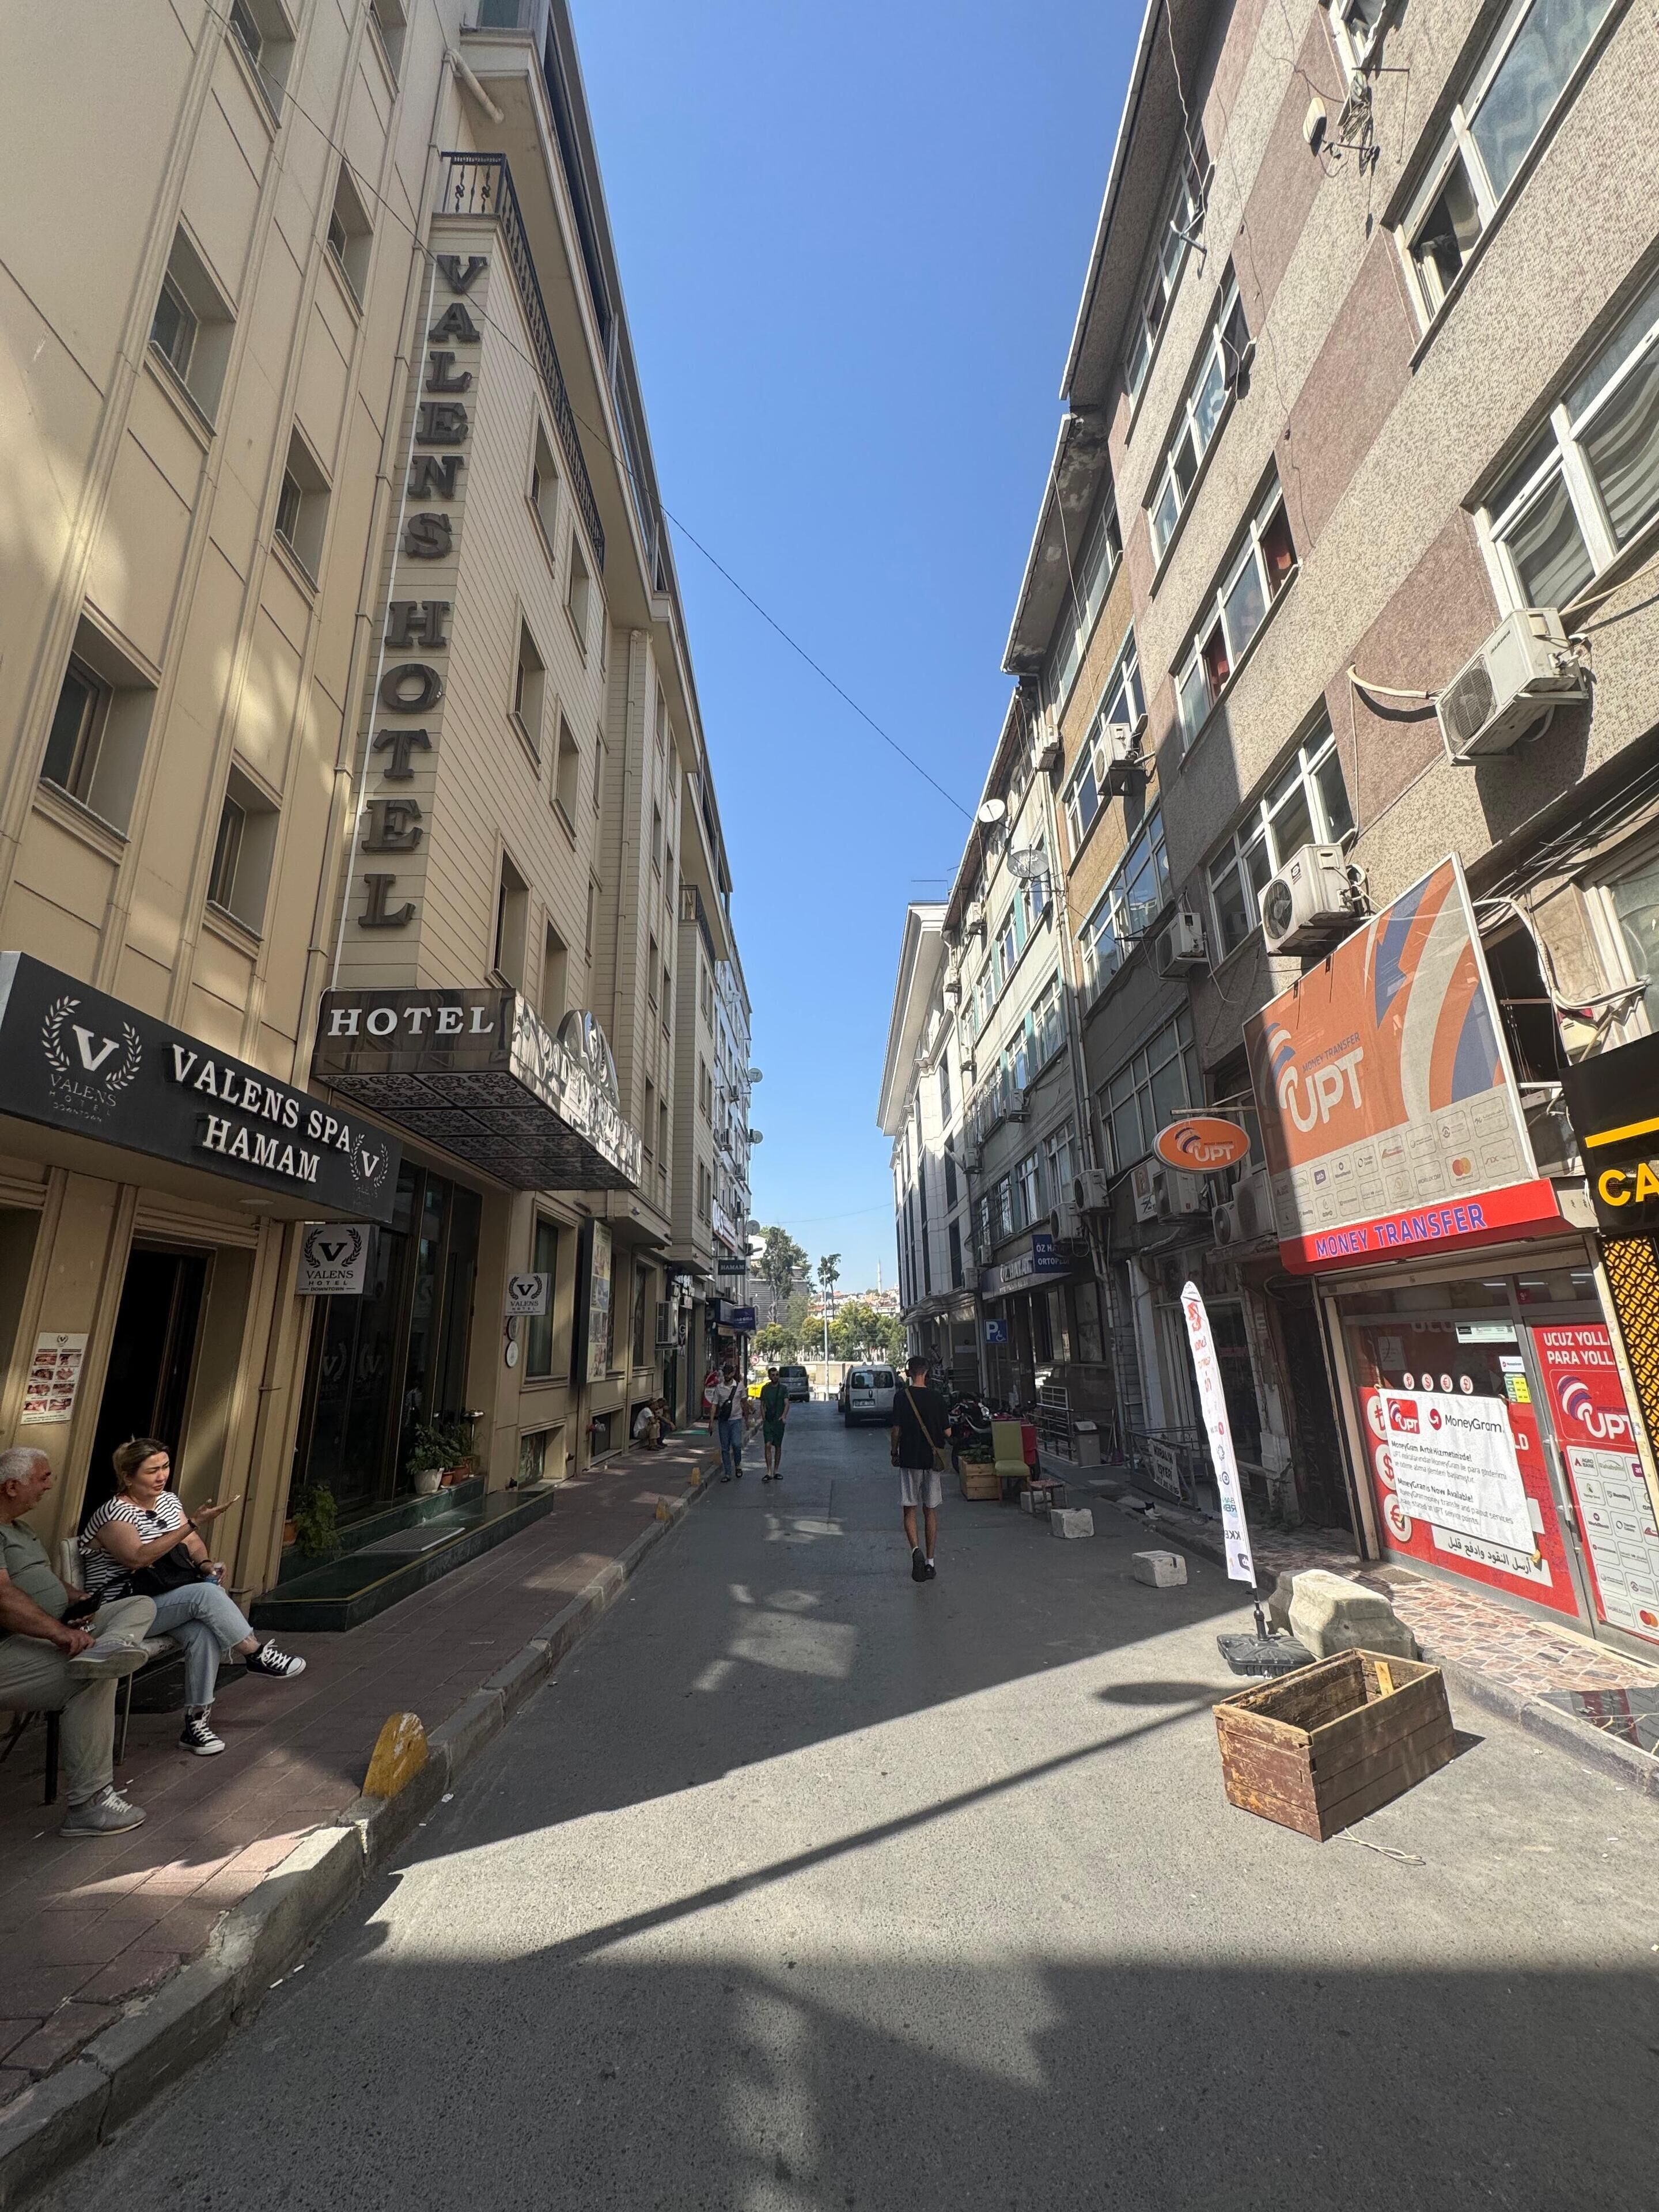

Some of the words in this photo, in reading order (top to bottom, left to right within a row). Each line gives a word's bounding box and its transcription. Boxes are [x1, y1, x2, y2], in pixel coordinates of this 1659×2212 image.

[404, 255, 488, 559] VALENS
[358, 600, 451, 929] HOTEL
[327, 1006, 495, 1036] HOTEL
[72, 1024, 120, 1071] V
[1302, 1054, 1324, 1073] MONEY
[1324, 1032, 1361, 1060] TRANSFER
[50, 1074, 116, 1107] VALENS
[172, 1044, 300, 1129] VALENS
[308, 1110, 351, 1153] SPA
[1287, 1046, 1365, 1132] UPT
[202, 1114, 321, 1184] HAMAM
[1194, 1145, 1234, 1162] UPT
[361, 1150, 380, 1178] V
[1598, 1162, 1659, 1206] CA
[1316, 1228, 1368, 1258] MONEY
[1373, 1203, 1487, 1247] TRANSFER
[319, 1243, 347, 1262] V
[306, 1270, 354, 1279] VALENS
[517, 1285, 534, 1296] V
[986, 1321, 998, 1340] P
[1543, 1332, 1575, 1346] UCUZ
[1575, 1331, 1613, 1346] YOLL
[1547, 1351, 1581, 1365] PARA
[1580, 1351, 1616, 1365] YOLL
[1398, 1416, 1418, 1432] UPT
[1445, 1414, 1503, 1433] MoneyGram
[1391, 1441, 1418, 1452] MoneyGram
[1468, 1466, 1480, 1474] para
[1431, 1486, 1445, 1495] Now
[1447, 1488, 1474, 1502] Available!
[1448, 1536, 1462, 1551] قليل
[1464, 1541, 1486, 1560] وادفع
[1487, 1551, 1510, 1566] النقود
[1512, 1556, 1532, 1574] أرسل
